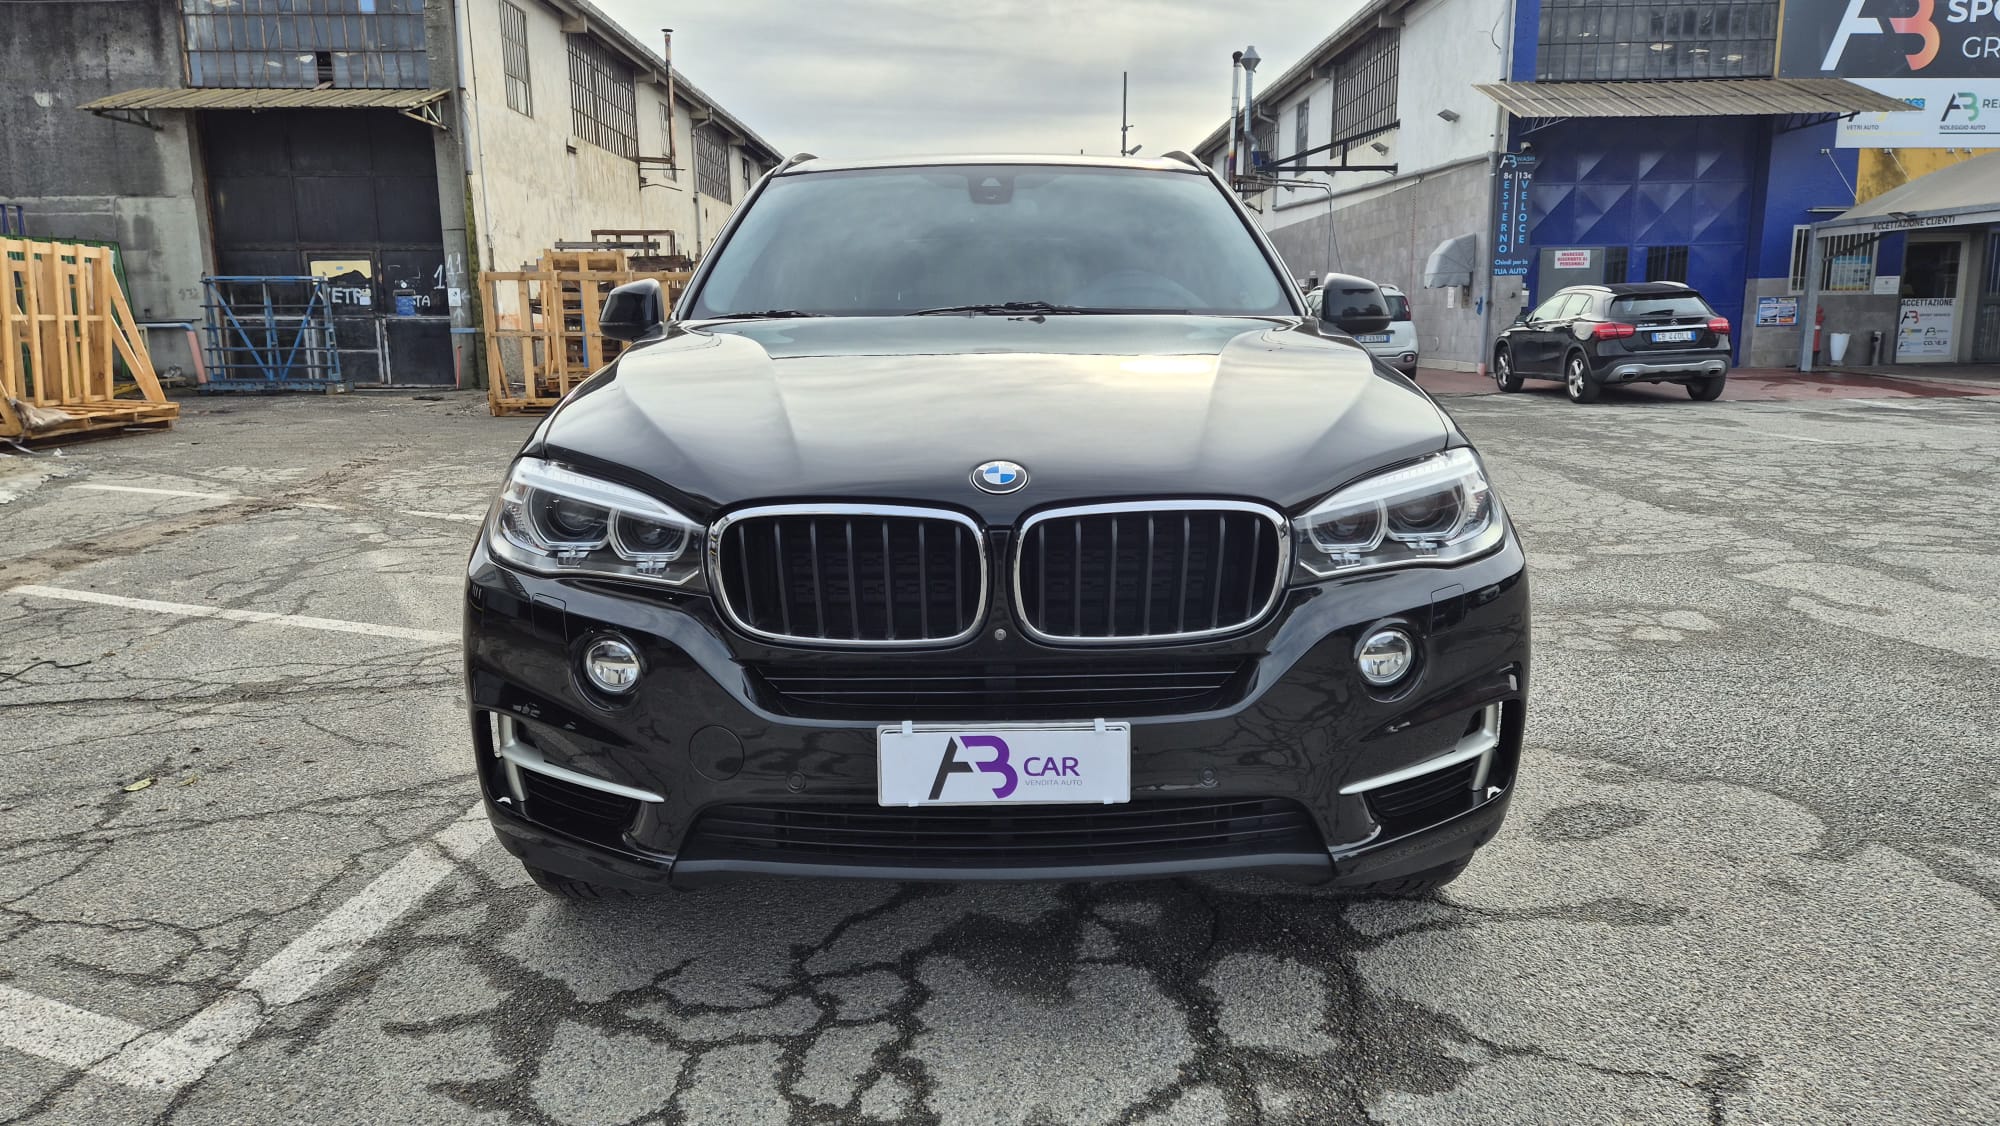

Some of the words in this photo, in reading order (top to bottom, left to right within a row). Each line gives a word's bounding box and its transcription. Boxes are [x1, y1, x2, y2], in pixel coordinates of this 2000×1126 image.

[1498, 180, 1511, 254] ESTERNO
[1518, 180, 1530, 244] VELOCE
[1925, 215, 1956, 226] CLIENTI
[1509, 267, 1528, 275] AUTO
[1900, 298, 1953, 307] ACCETTAZIONE
[1023, 756, 1081, 777] CAR
